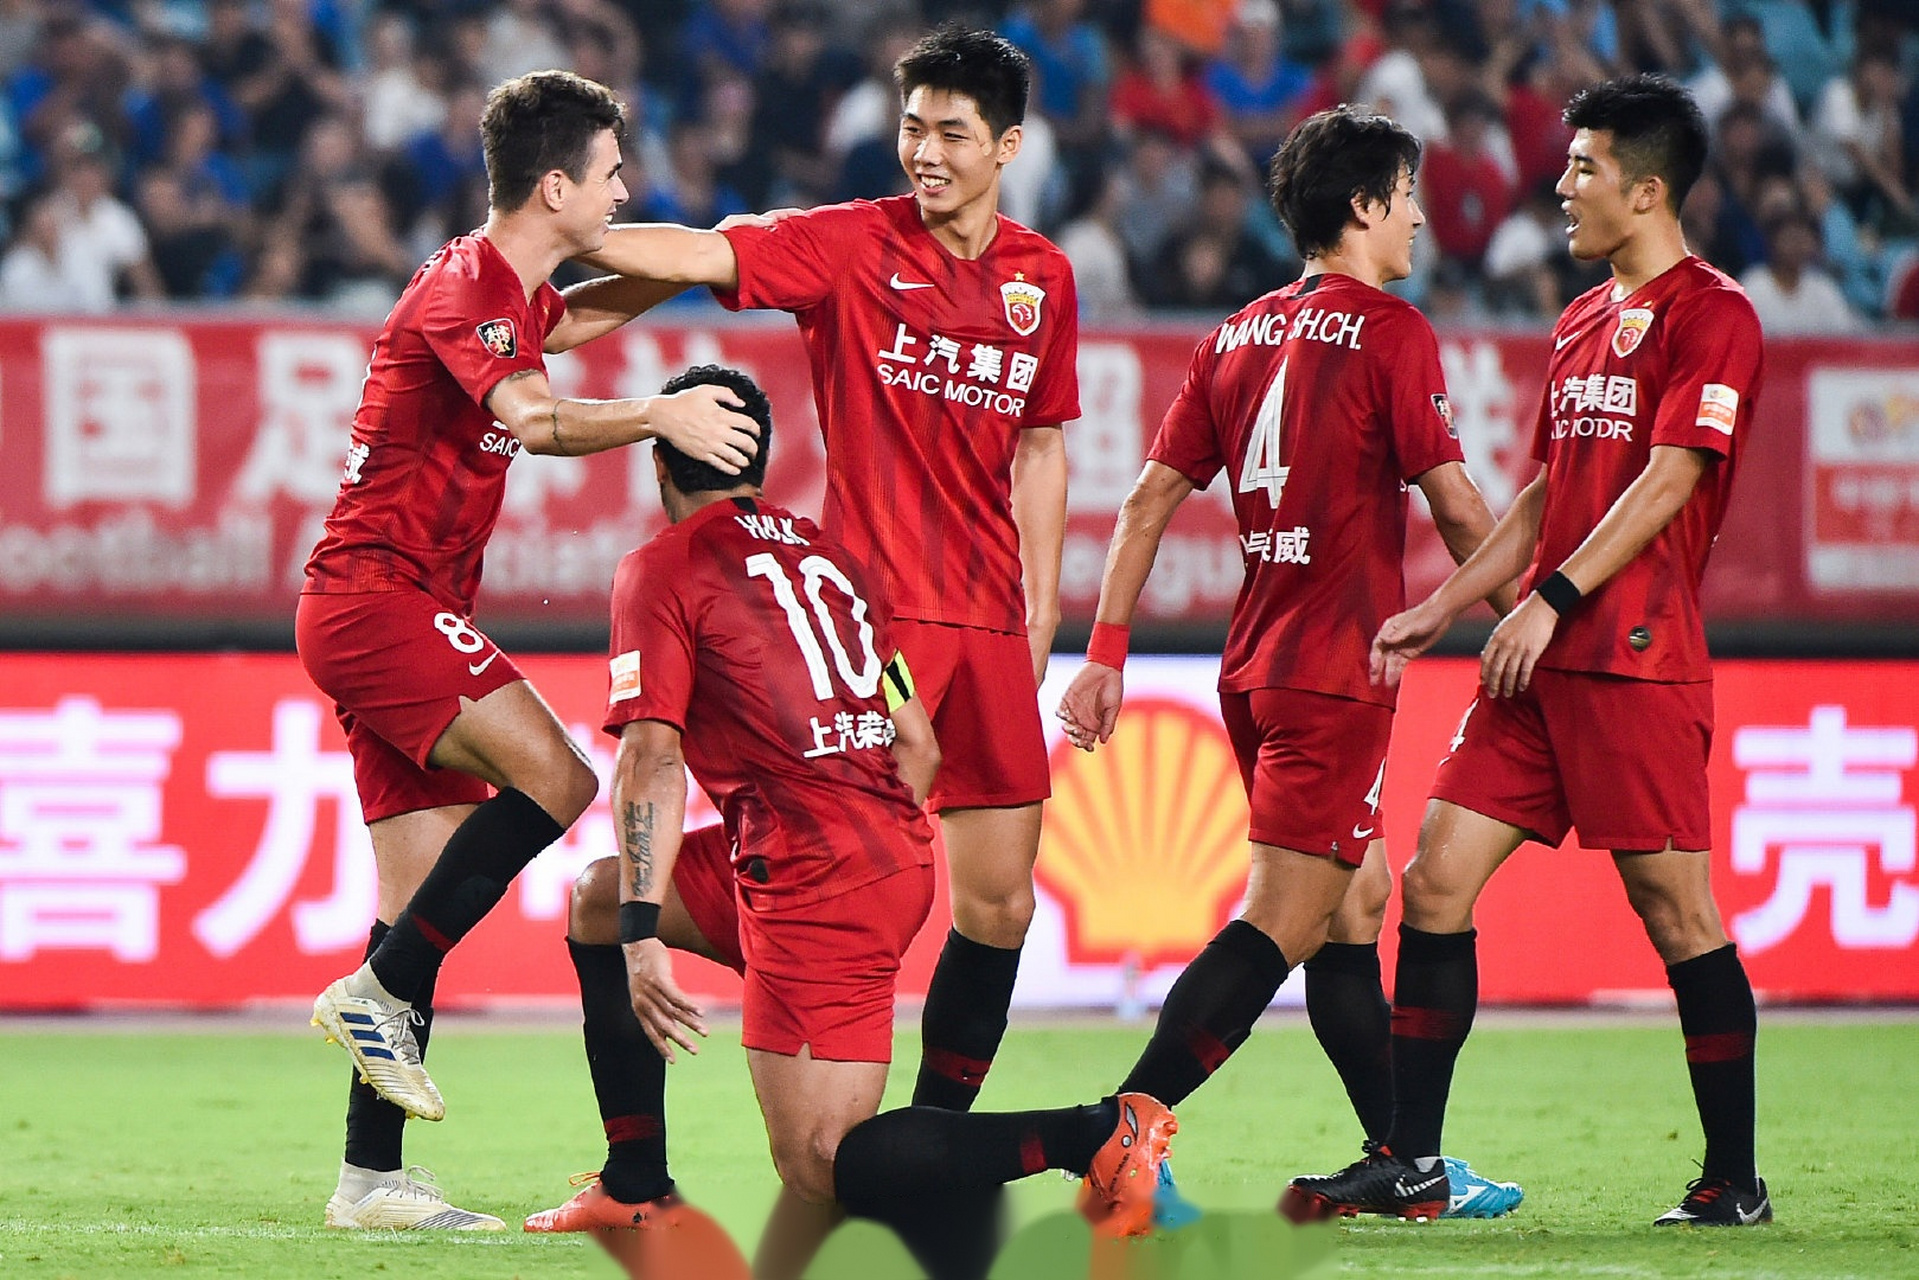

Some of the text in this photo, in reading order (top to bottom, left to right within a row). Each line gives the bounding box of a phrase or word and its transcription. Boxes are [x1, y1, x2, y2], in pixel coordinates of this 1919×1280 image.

[877, 323, 1039, 394] 上汽集团
[1215, 308, 1365, 354] WANG SH.CH.
[877, 363, 1026, 418] SAIC MOTOR
[479, 432, 521, 458] SAIC
[1238, 354, 1291, 510] 4
[433, 612, 485, 654] 8
[744, 552, 883, 701] 10
[1363, 757, 1387, 816] 4
[1732, 704, 1919, 955] 壳
